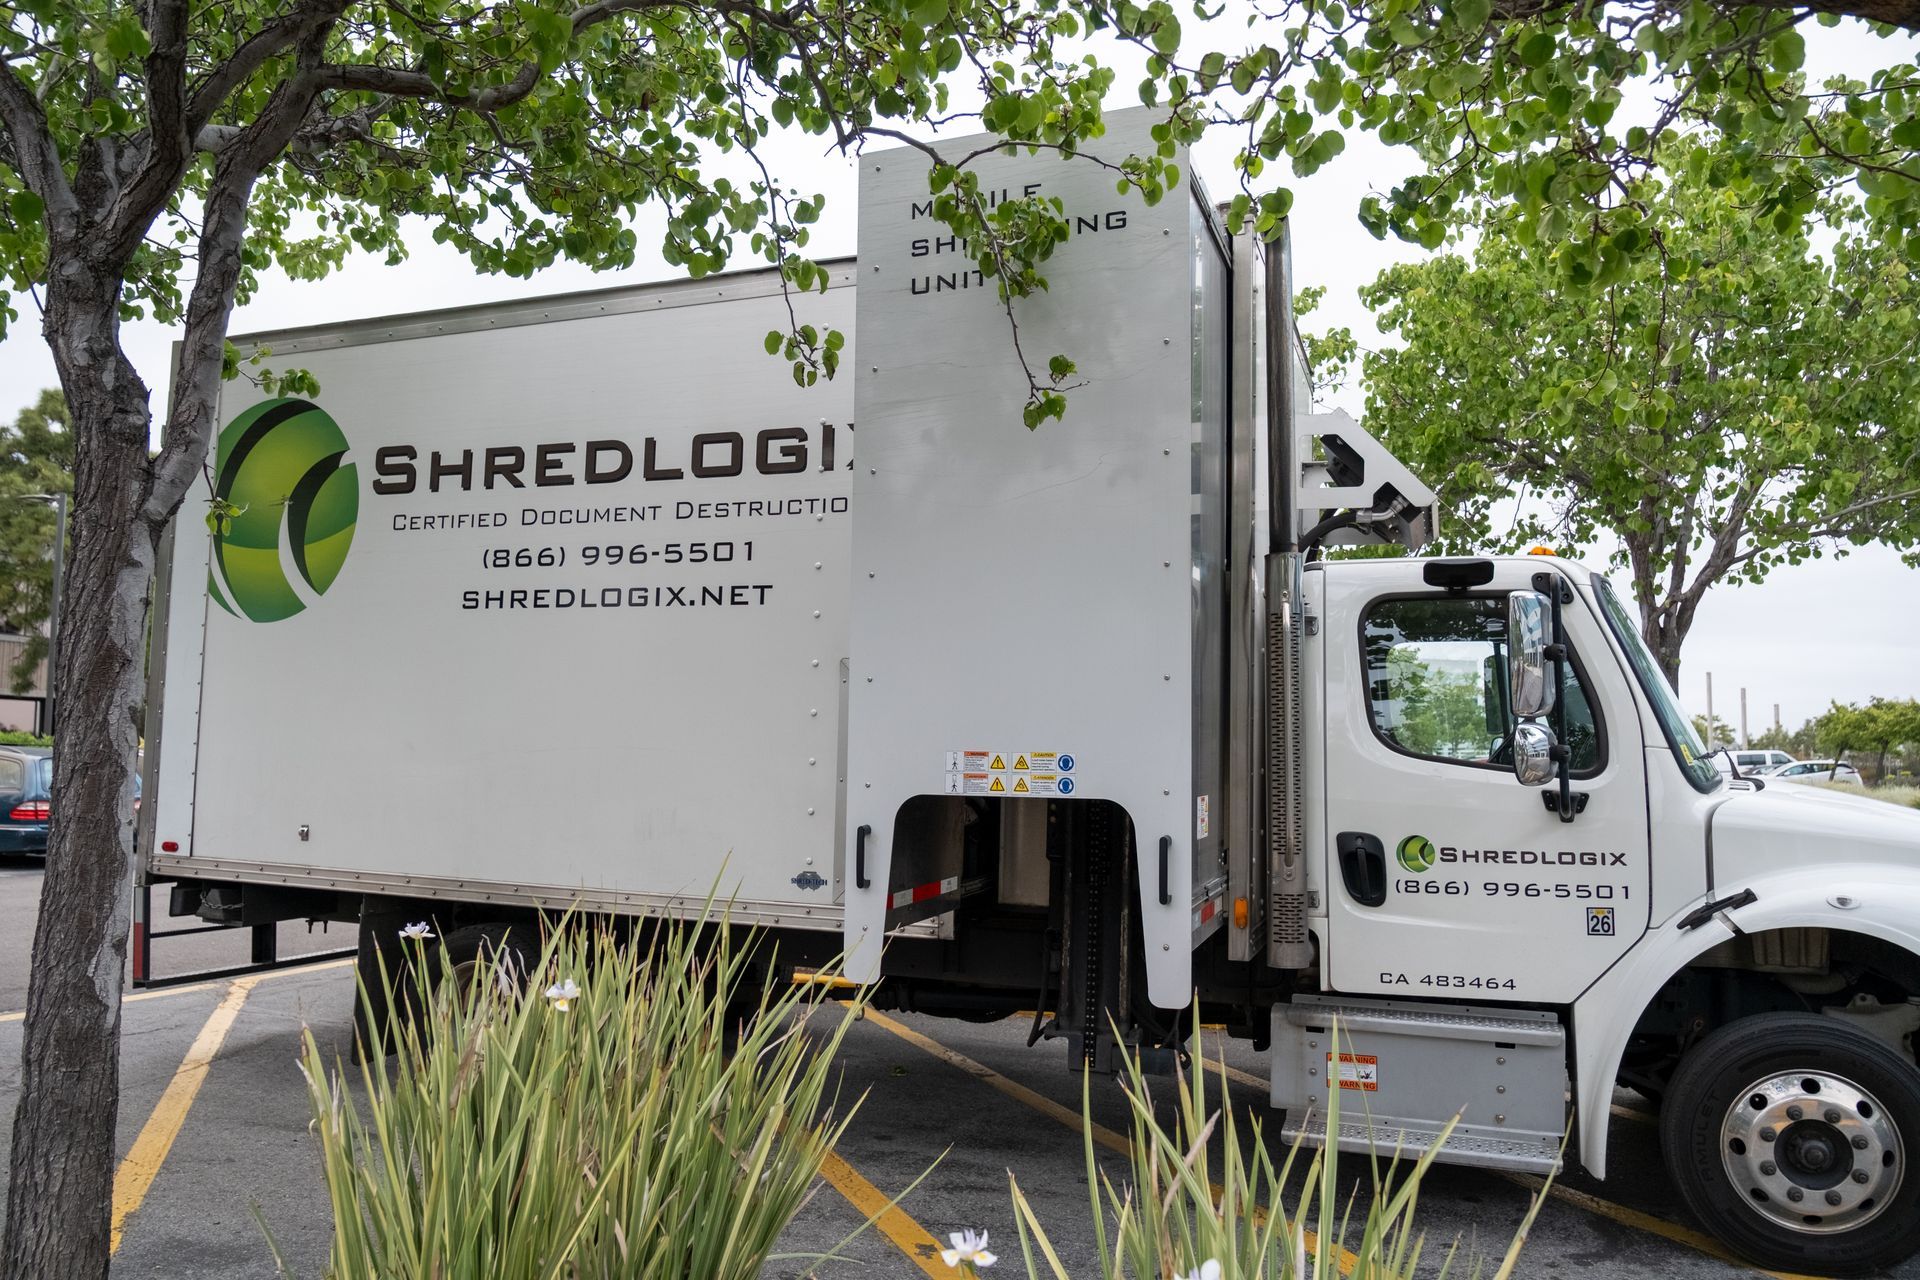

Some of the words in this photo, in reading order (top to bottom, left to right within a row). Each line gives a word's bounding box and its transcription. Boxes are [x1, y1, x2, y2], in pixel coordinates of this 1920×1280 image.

[912, 269, 984, 295] UNIT
[373, 424, 853, 495] SHREDLOGI
[393, 513, 507, 531] CERTIFIED
[521, 506, 661, 526] DOCUMENT
[676, 497, 848, 521] DESTRUCTIO
[483, 547, 566, 569] (866)
[582, 541, 753, 566] 996-5501
[462, 585, 773, 609] SHREDLOGIX.NET
[1440, 847, 1627, 866] SHREDLOGIX
[1396, 879, 1469, 896] (866)
[1483, 882, 1629, 899] 996-5501
[1590, 915, 1611, 933] 26
[1380, 973, 1410, 985] CA
[1420, 975, 1516, 990] 483464
[1338, 1080, 1376, 1090] ARNNG
